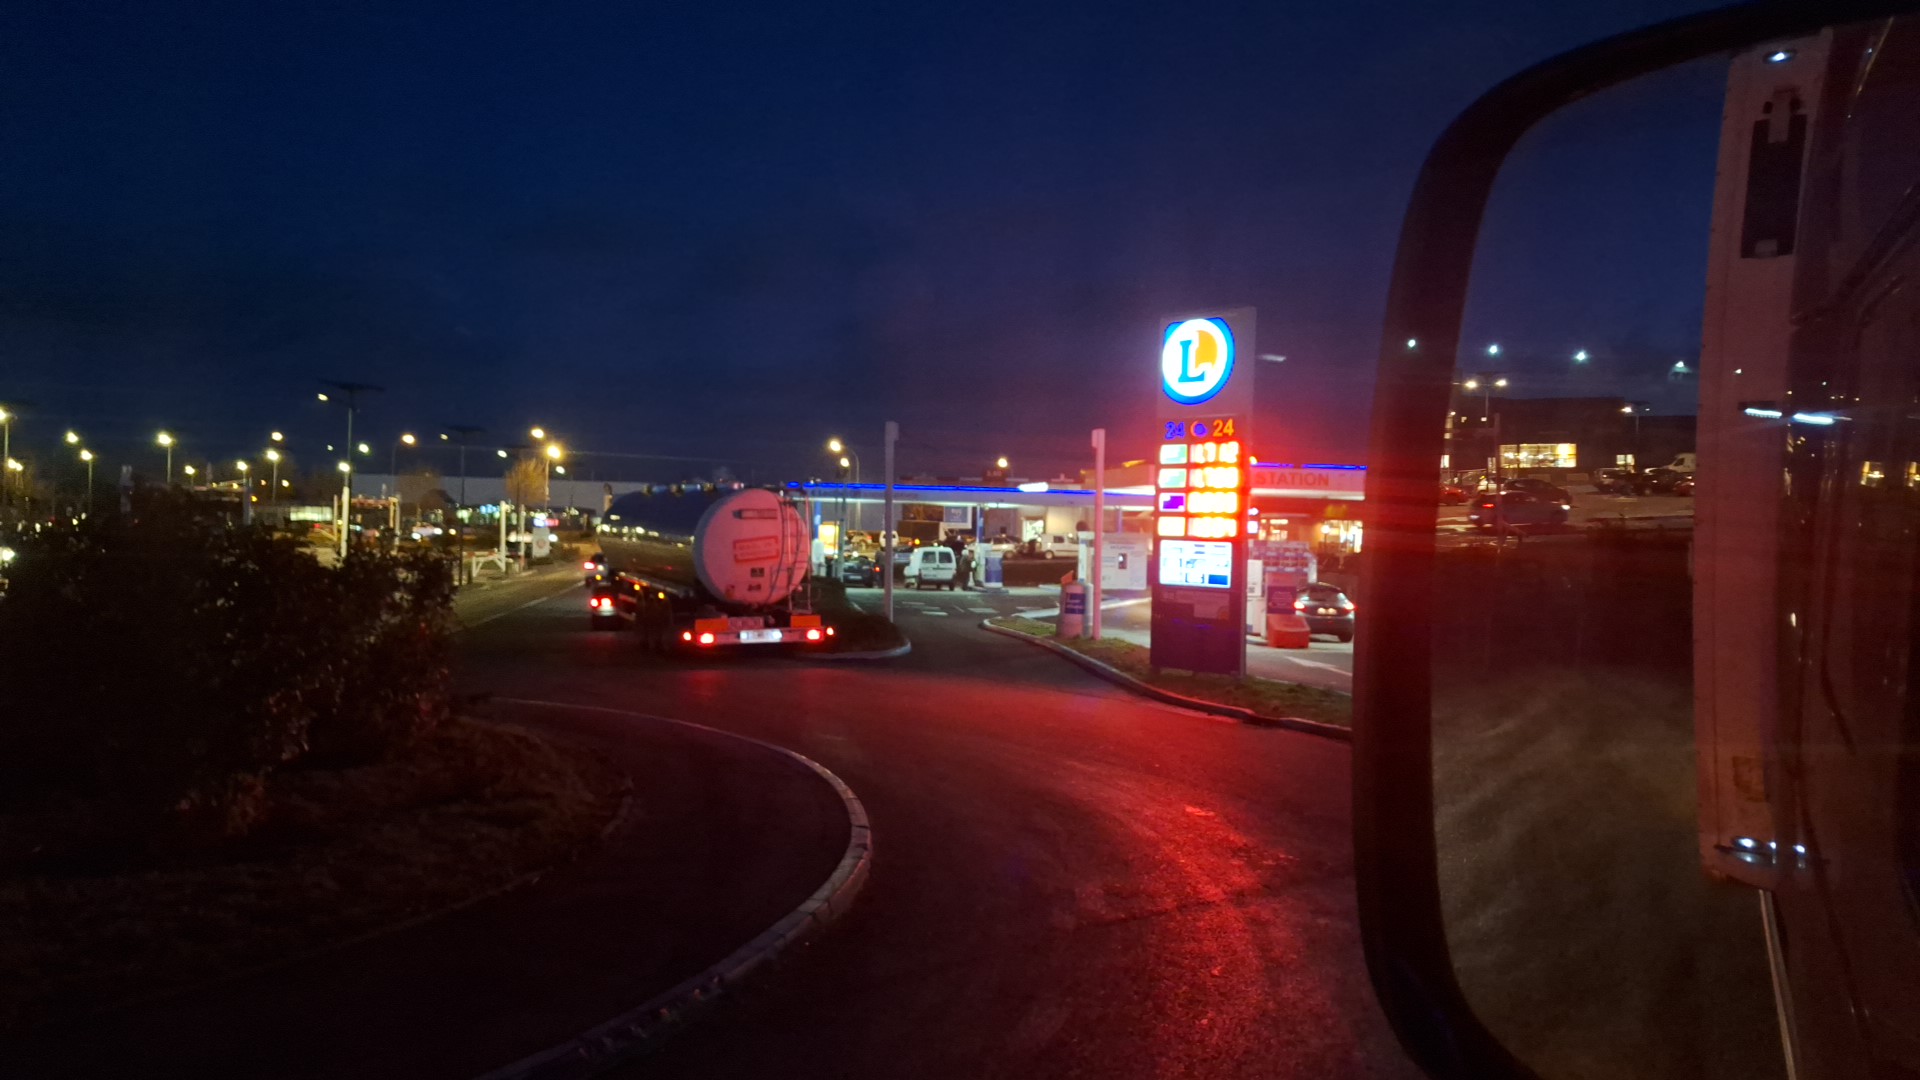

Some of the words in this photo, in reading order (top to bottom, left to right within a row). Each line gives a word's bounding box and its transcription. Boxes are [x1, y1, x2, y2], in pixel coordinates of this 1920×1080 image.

[1178, 340, 1205, 383] L
[1165, 421, 1186, 440] 24
[1212, 418, 1235, 437] 24
[1255, 471, 1330, 487] STATION
